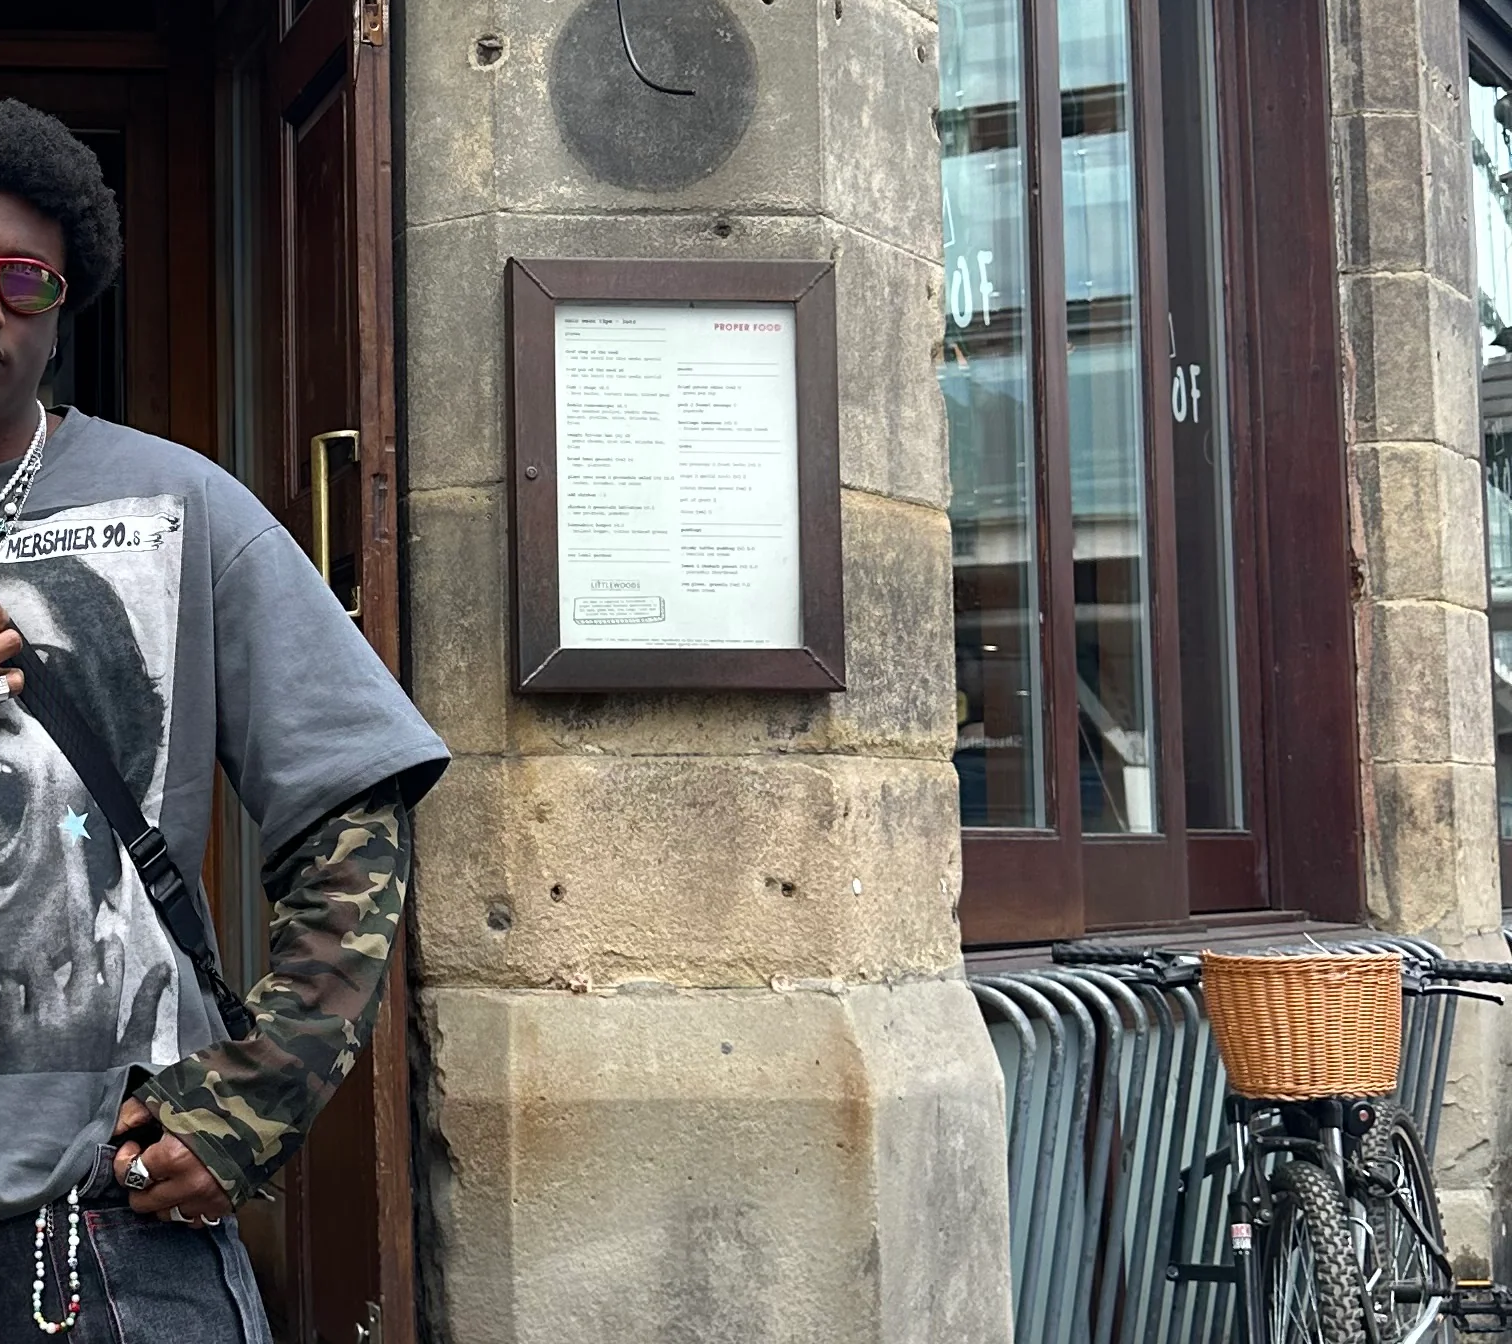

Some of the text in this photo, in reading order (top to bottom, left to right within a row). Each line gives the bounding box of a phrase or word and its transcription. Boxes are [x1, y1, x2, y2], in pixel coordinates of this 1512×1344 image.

[714, 323, 782, 332] PROPER FOOD
[6, 525, 98, 559] MERSHIER
